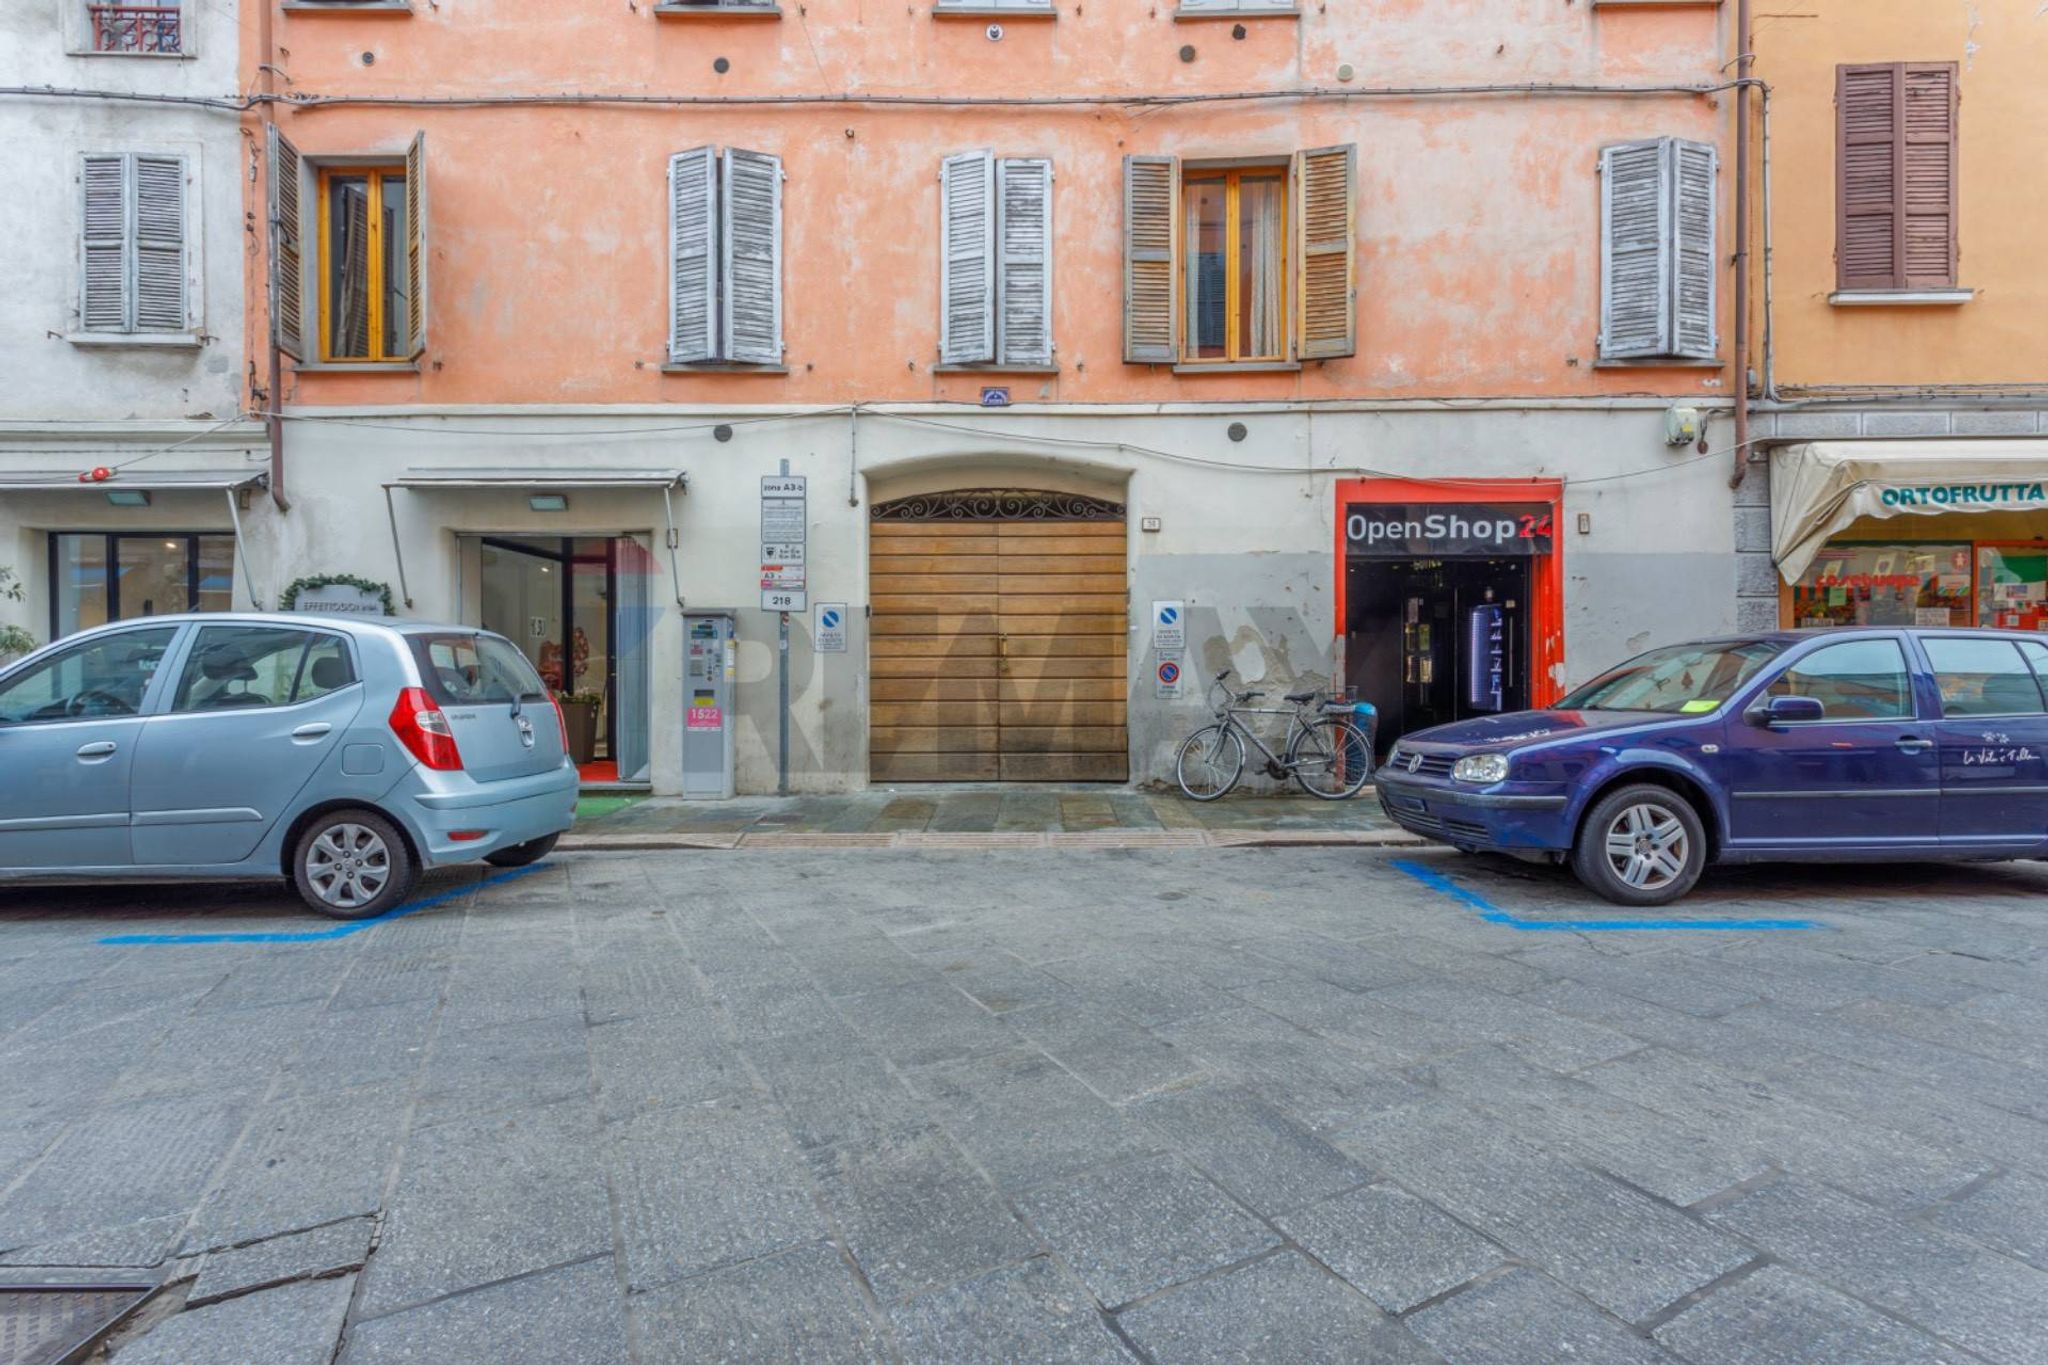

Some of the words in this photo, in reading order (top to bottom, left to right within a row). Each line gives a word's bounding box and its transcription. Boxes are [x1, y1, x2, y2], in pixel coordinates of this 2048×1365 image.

[1882, 483, 2045, 506] ORTOFRUTTA
[772, 596, 791, 605] 218
[691, 708, 718, 720] 1522
